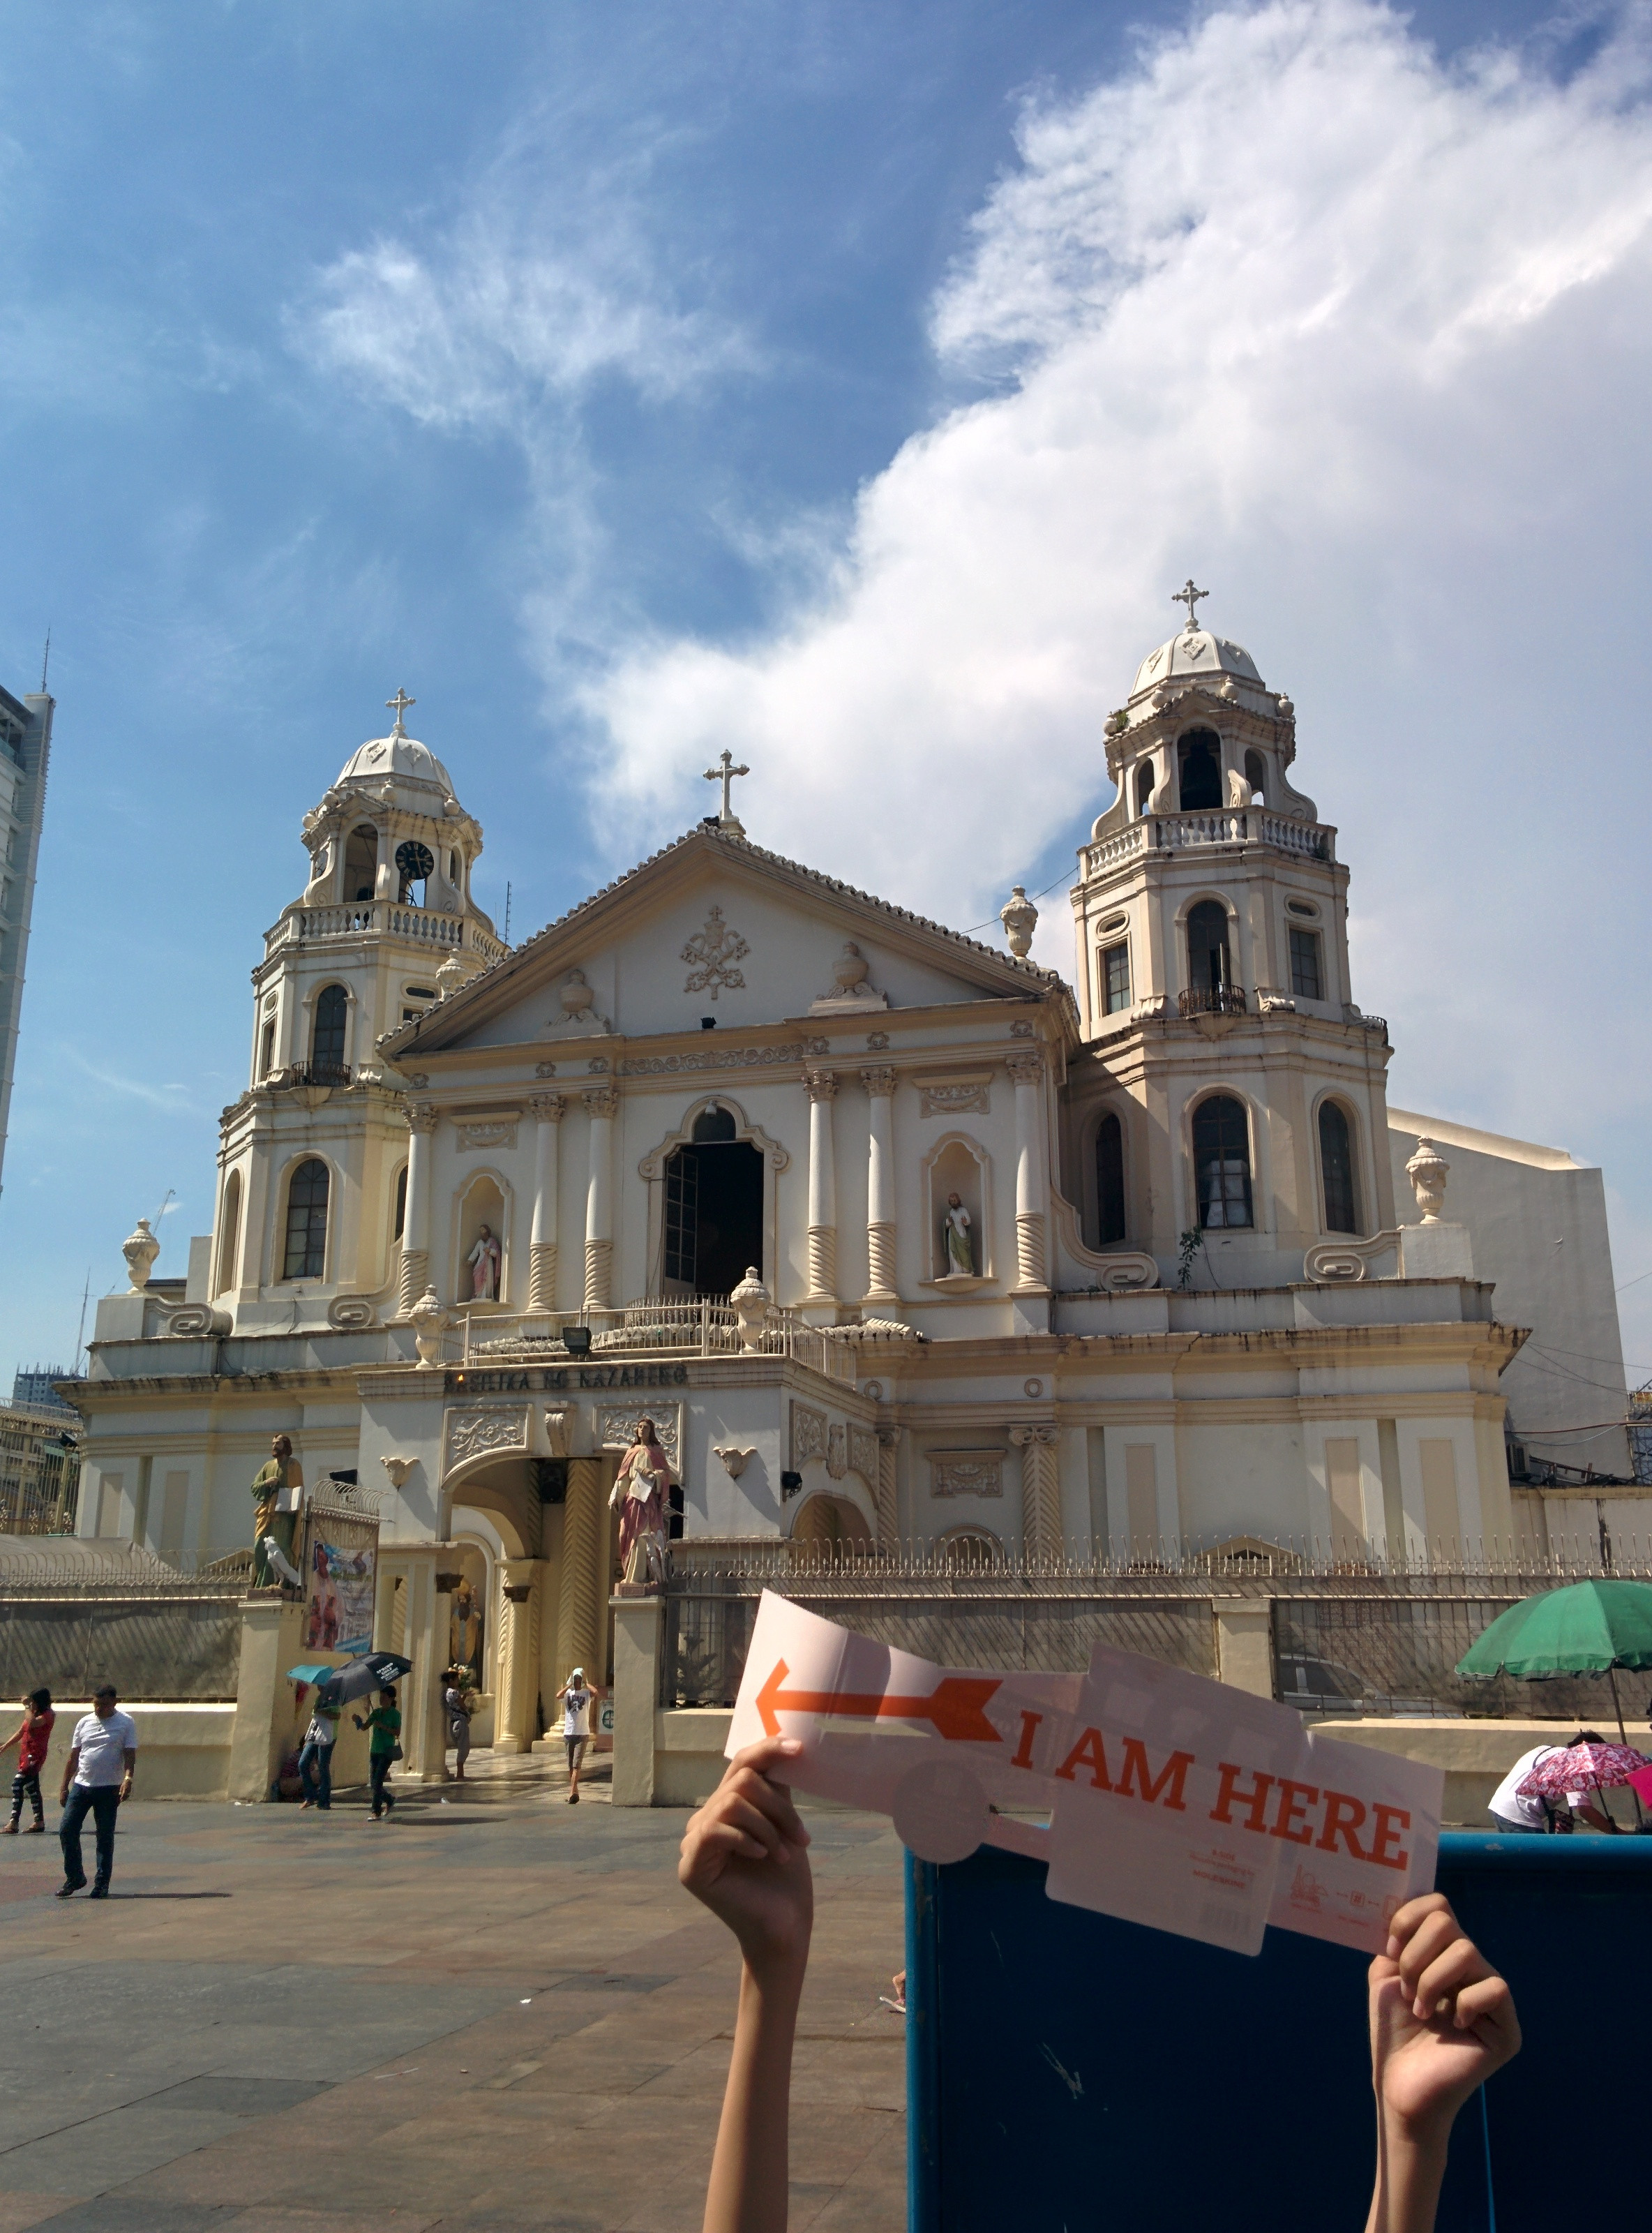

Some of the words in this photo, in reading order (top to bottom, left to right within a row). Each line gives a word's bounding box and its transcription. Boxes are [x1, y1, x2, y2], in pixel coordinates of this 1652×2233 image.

[1010, 1710, 1043, 1769] I
[1055, 1726, 1195, 1810] AM
[1209, 1762, 1411, 1871] HERE
